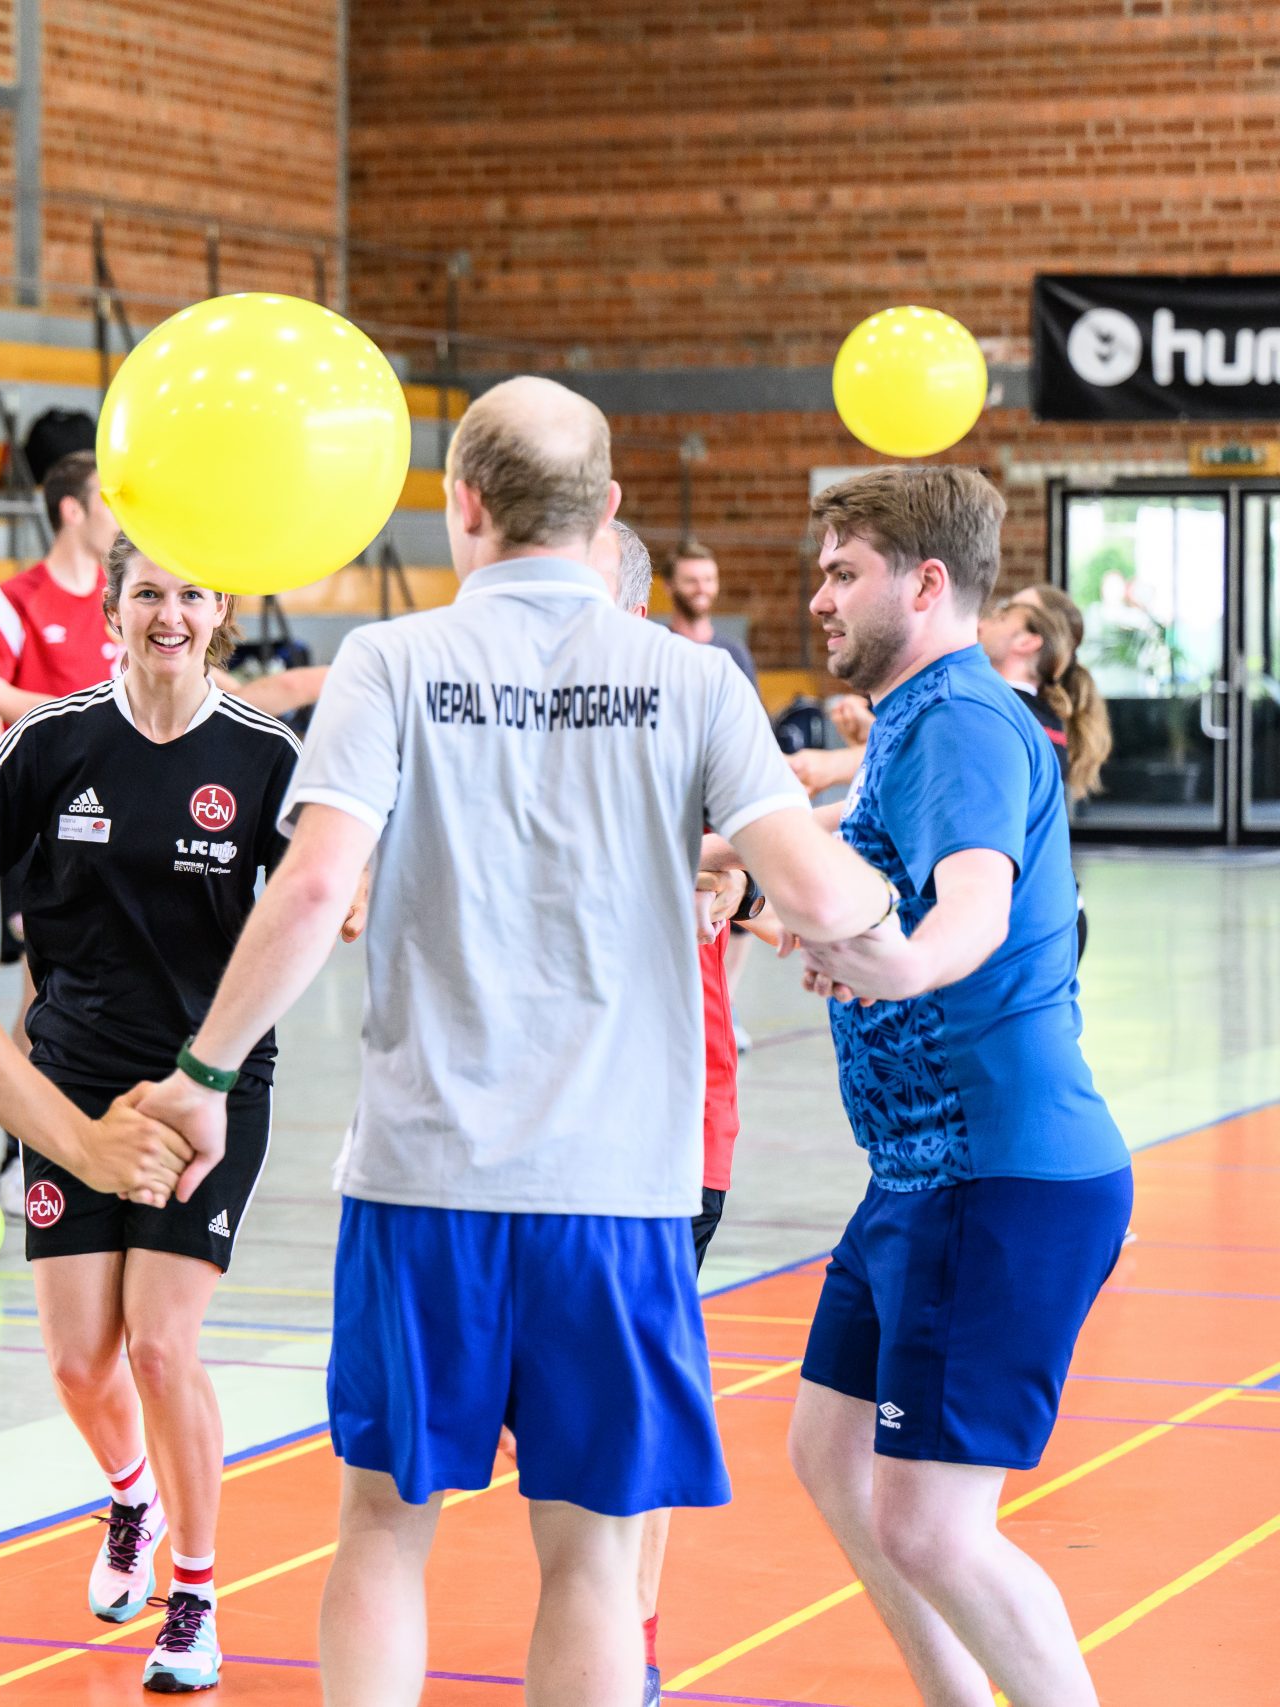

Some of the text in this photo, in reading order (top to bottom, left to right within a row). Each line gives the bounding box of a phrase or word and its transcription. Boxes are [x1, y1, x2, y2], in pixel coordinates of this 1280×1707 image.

[426, 681, 487, 725] NEPAL
[68, 803, 105, 814] adidas
[195, 801, 230, 822] FCN
[190, 839, 209, 856] FC
[173, 864, 205, 874] BEWEGT
[29, 1200, 59, 1218] FCN
[208, 1223, 231, 1239] adidas
